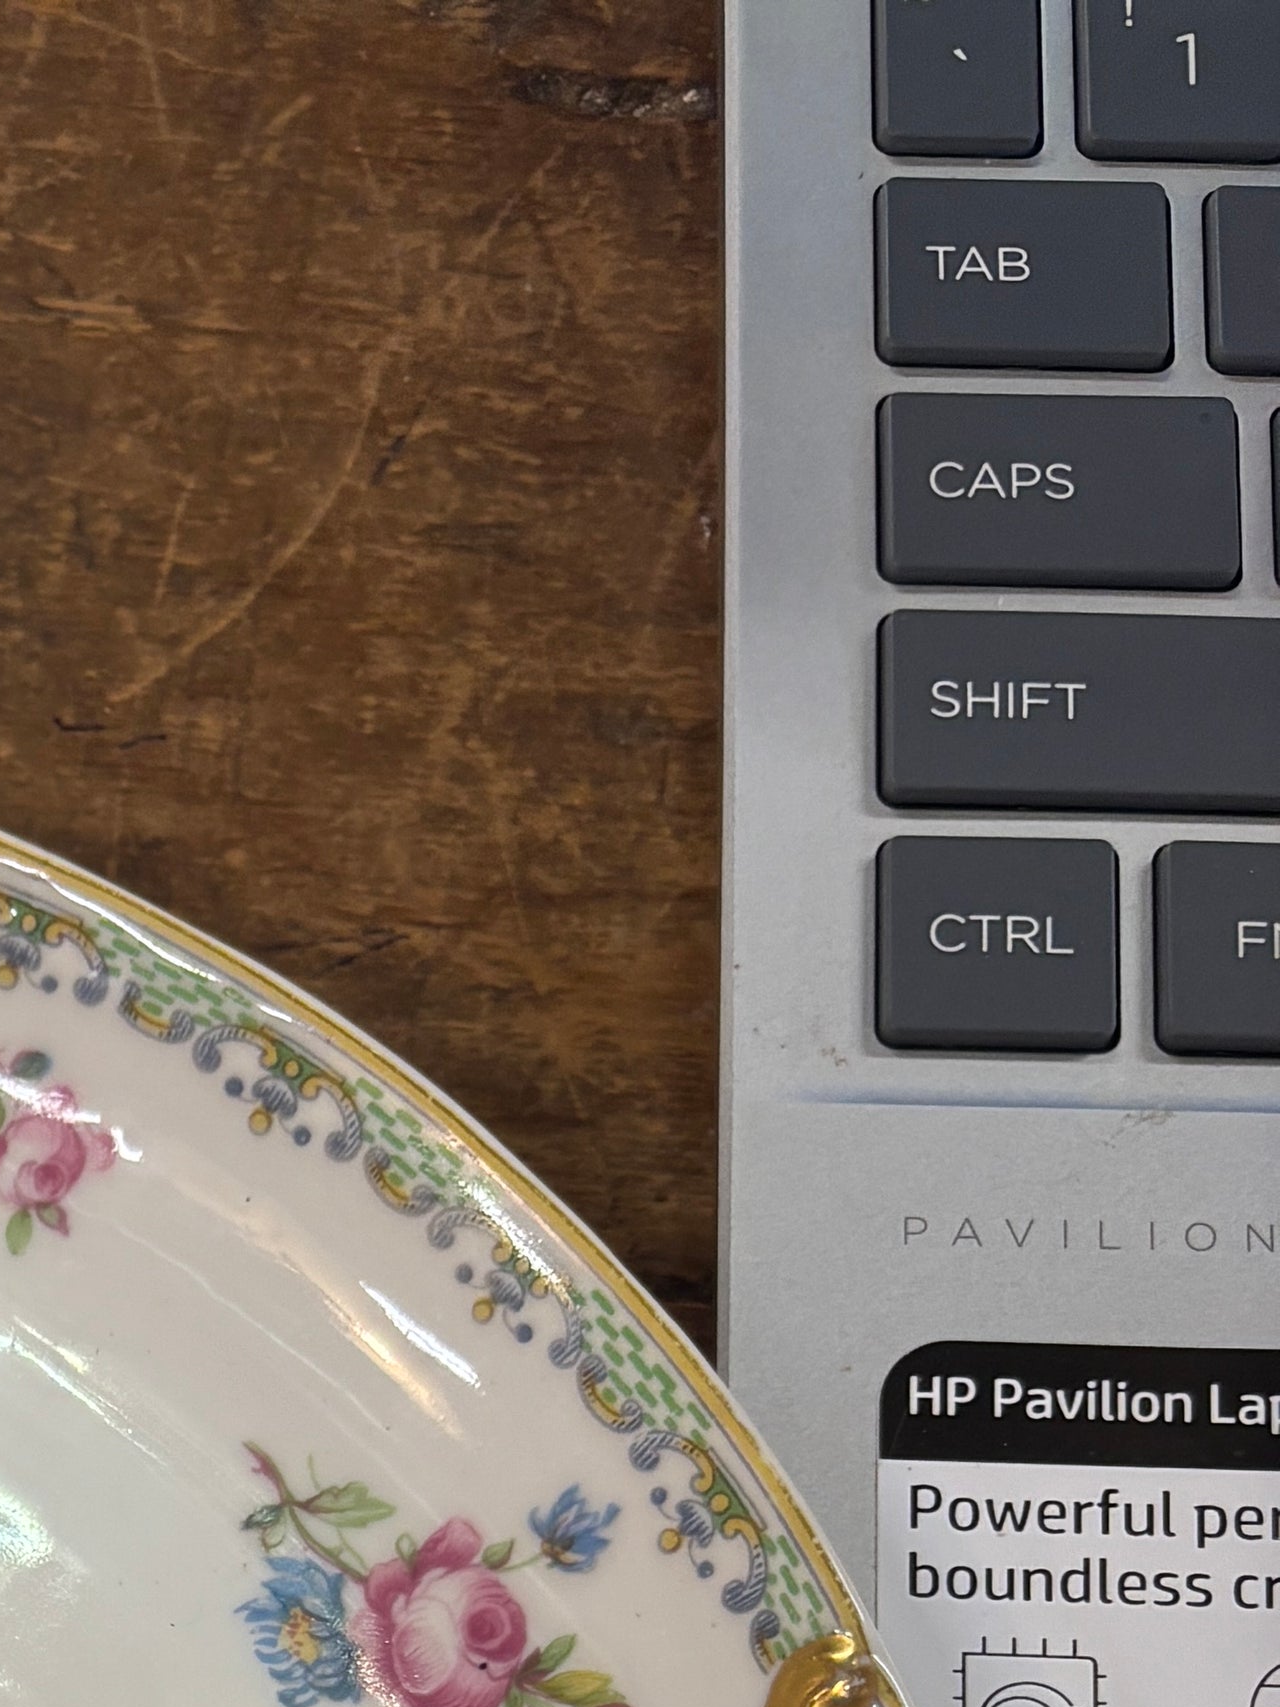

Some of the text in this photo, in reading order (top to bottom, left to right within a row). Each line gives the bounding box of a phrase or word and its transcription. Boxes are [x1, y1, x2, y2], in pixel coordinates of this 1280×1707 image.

[1175, 32, 1197, 86] 1
[925, 245, 1032, 283] TAB
[928, 460, 1076, 501] CAPS
[929, 680, 1088, 721] SHIFT
[928, 913, 1076, 955] CTRL
[902, 1215, 1276, 1253] PAVILION
[908, 1374, 977, 1417] HP
[992, 1376, 1193, 1425] Pavilion
[908, 1483, 1177, 1539] Powerful
[907, 1550, 1214, 1609] boundless
